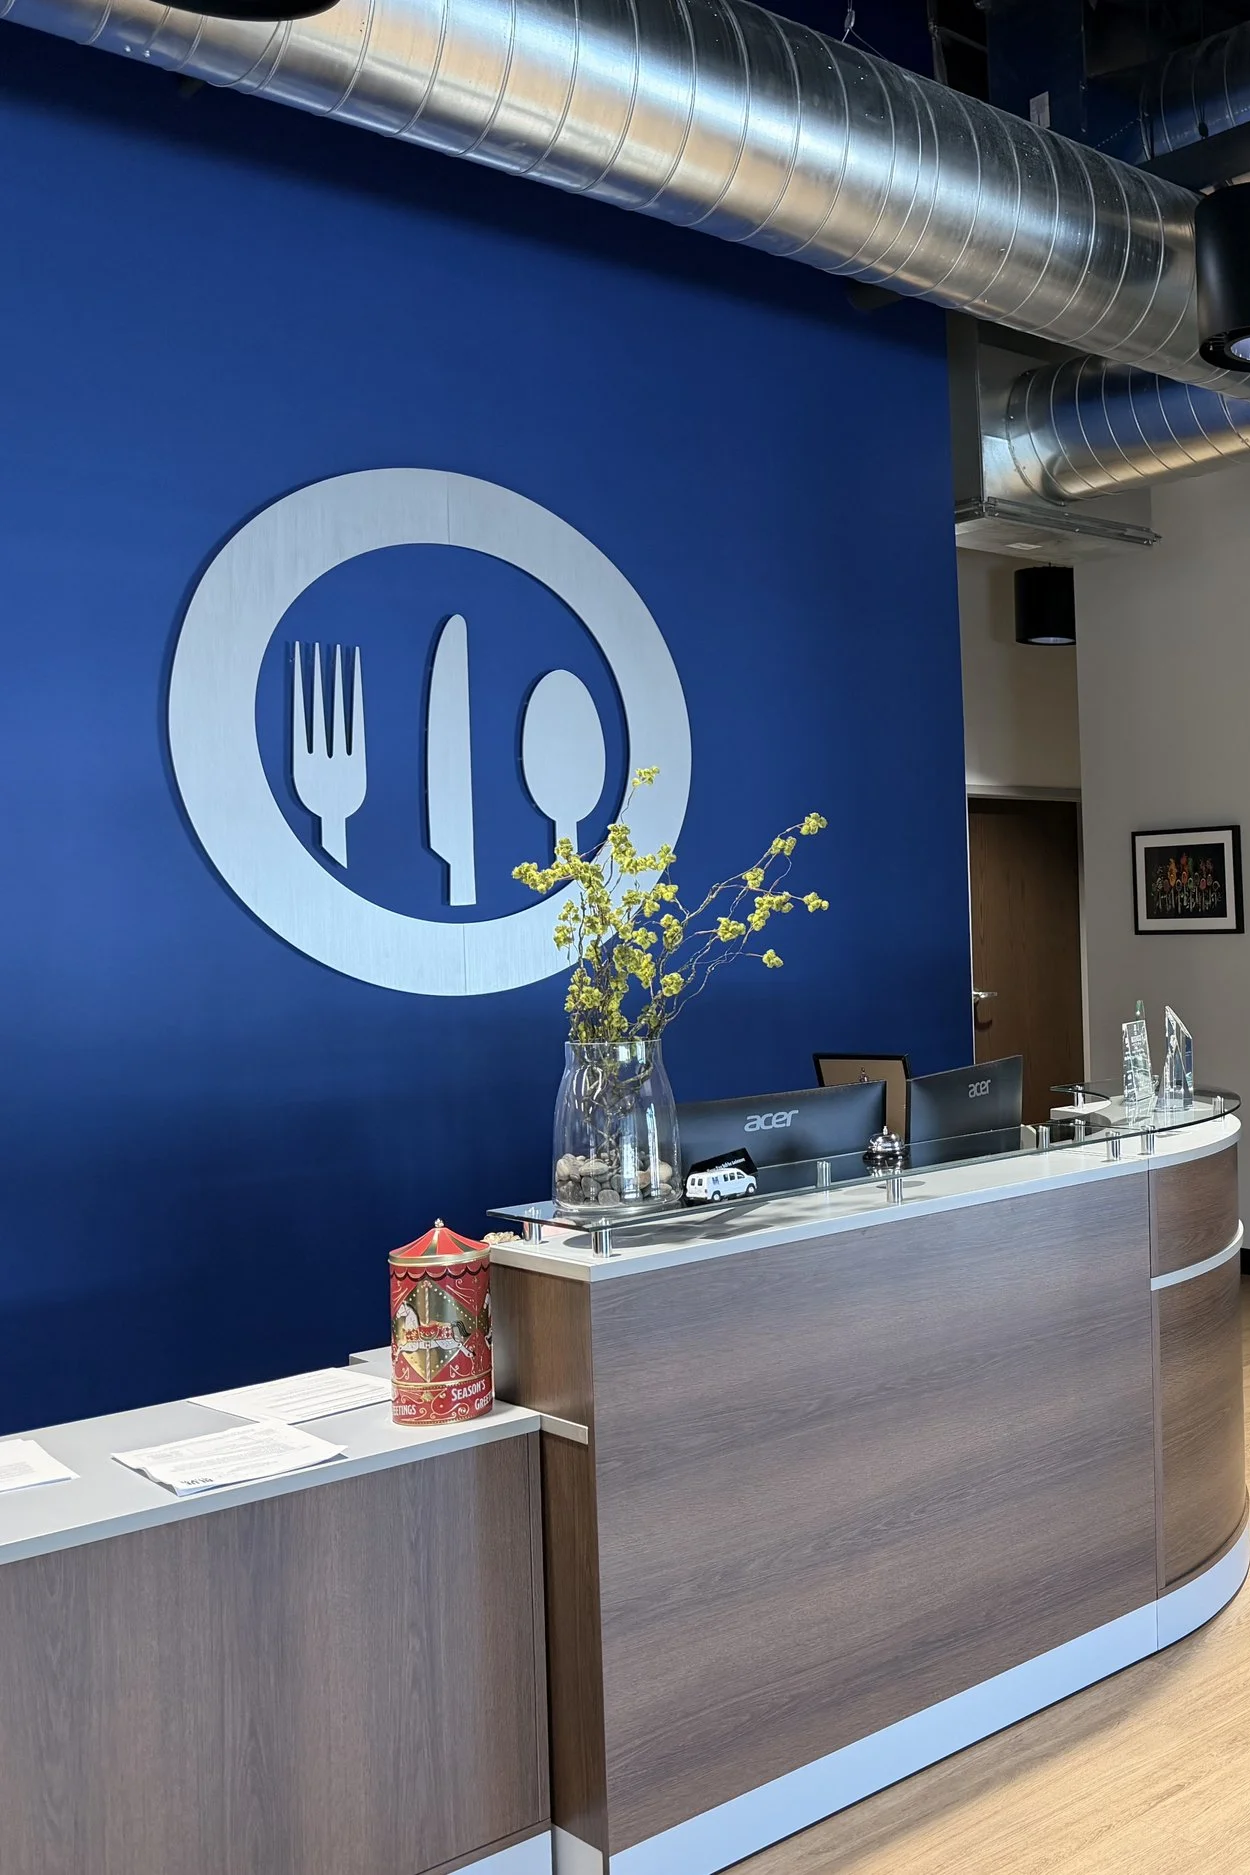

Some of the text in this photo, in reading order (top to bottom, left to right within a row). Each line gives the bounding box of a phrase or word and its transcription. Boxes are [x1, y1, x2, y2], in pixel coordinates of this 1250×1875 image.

[968, 1079, 991, 1098] acer
[743, 1109, 799, 1132] acer
[451, 1379, 486, 1402] SEASON'S
